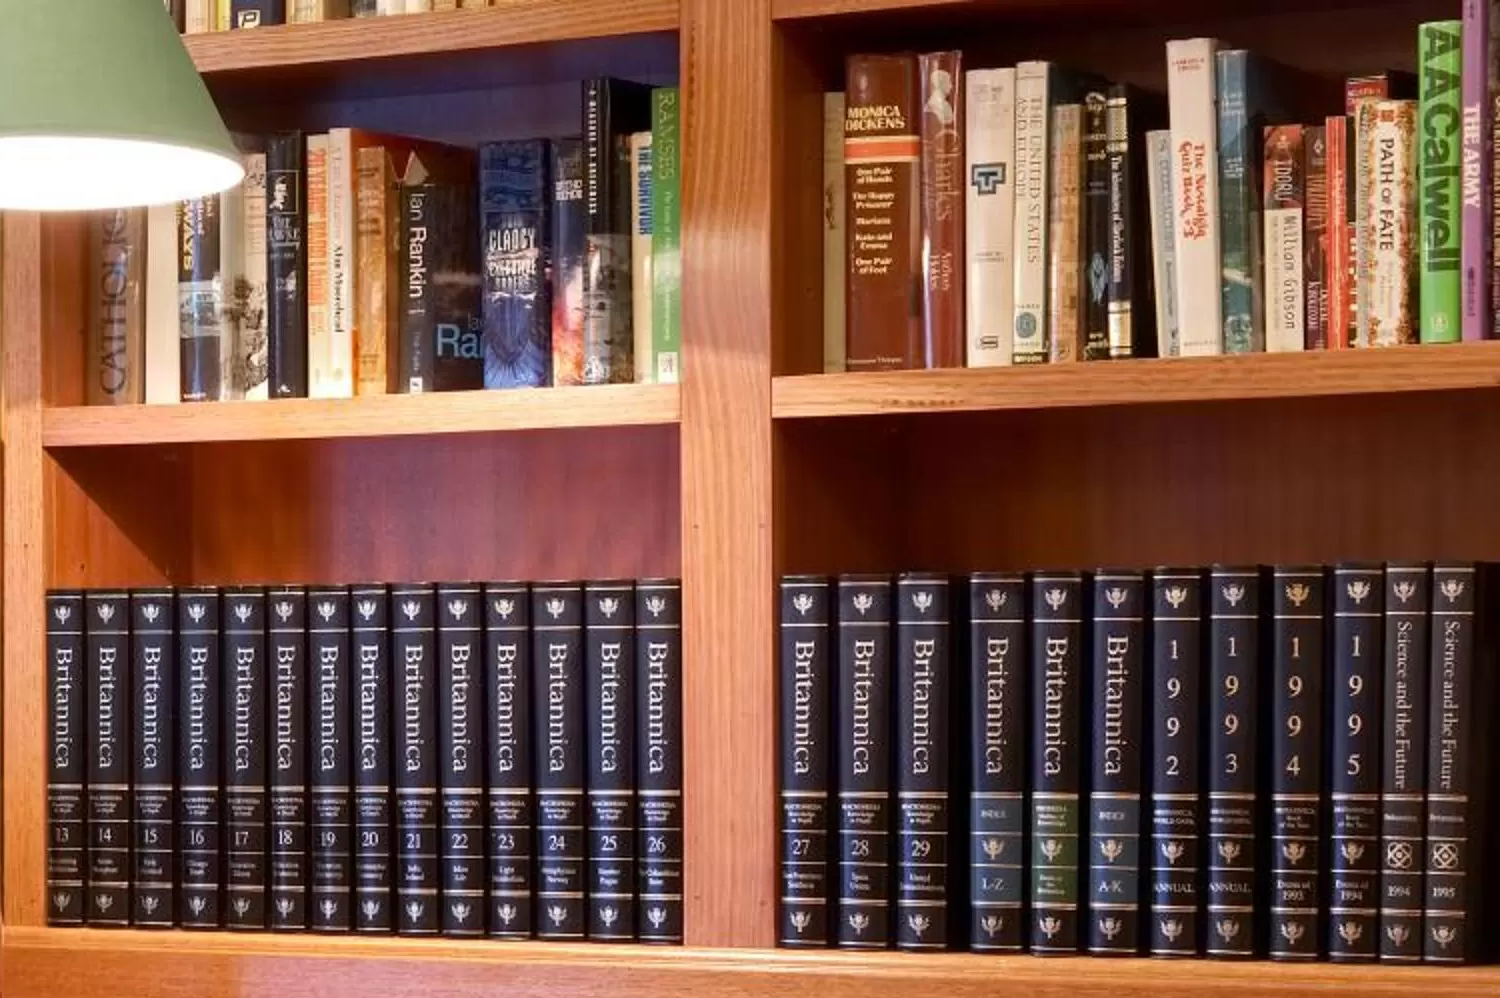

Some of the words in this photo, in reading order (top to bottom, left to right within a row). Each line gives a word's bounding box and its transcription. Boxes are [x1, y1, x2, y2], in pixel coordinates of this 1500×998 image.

[659, 91, 676, 180] RAMSES
[845, 117, 906, 131] DICKENS
[847, 105, 900, 119] MONICA
[1017, 98, 1029, 131] AND
[1030, 97, 1043, 131] THE
[1463, 103, 1481, 143] THE
[639, 147, 652, 170] THE
[1029, 135, 1042, 199] UNITED
[1379, 136, 1395, 183] PATH
[1463, 146, 1481, 208] ARMY
[410, 193, 426, 221] Ian
[638, 171, 653, 236] SURVIVOR
[1380, 208, 1395, 250] FATE
[489, 227, 536, 251] CLANCY
[1027, 202, 1041, 264] STATES
[1283, 214, 1298, 270] William
[409, 226, 427, 299] Rankin
[1282, 278, 1298, 329] Gibson
[1395, 621, 1412, 678] Science
[1442, 621, 1460, 678] Science
[55, 647, 73, 769] Britannica
[99, 646, 117, 768] Britannica
[143, 646, 161, 769] Britannica
[190, 646, 208, 769] Britannica
[235, 646, 255, 771] Britannica
[277, 644, 296, 769] Britannica
[320, 645, 339, 771] Britannica
[360, 643, 379, 770] Britannica
[405, 644, 424, 772] Britannica
[451, 643, 471, 772] Britannica
[497, 642, 517, 773] Britannica
[549, 642, 568, 772] Britannica
[601, 642, 621, 773] Britannica
[648, 641, 668, 774] Britannica
[794, 640, 815, 774] Britannica
[853, 638, 875, 775] Britannica
[913, 638, 935, 774] Britannica
[985, 637, 1009, 774] Britannica
[1043, 636, 1068, 776] Britannica
[1104, 635, 1129, 775] Britannica
[1395, 681, 1412, 709] and
[1442, 681, 1460, 709] and
[1395, 713, 1412, 737] the
[1442, 713, 1460, 737] the
[1395, 739, 1410, 790] Future
[1442, 739, 1458, 790] Future
[55, 828, 69, 843] 13
[98, 828, 112, 843] 14
[143, 828, 158, 844] 15
[190, 828, 204, 845] 16
[235, 830, 250, 847] 17
[278, 829, 293, 845] 18
[320, 830, 335, 847] 19
[360, 831, 379, 848] 20
[406, 834, 421, 850] 21
[451, 834, 469, 850] 22
[497, 834, 515, 851] 23
[548, 835, 566, 852] 24
[600, 835, 617, 851] 25
[647, 836, 667, 853] 26
[791, 837, 811, 857] 27
[851, 837, 870, 857] 28
[910, 838, 932, 858] 29
